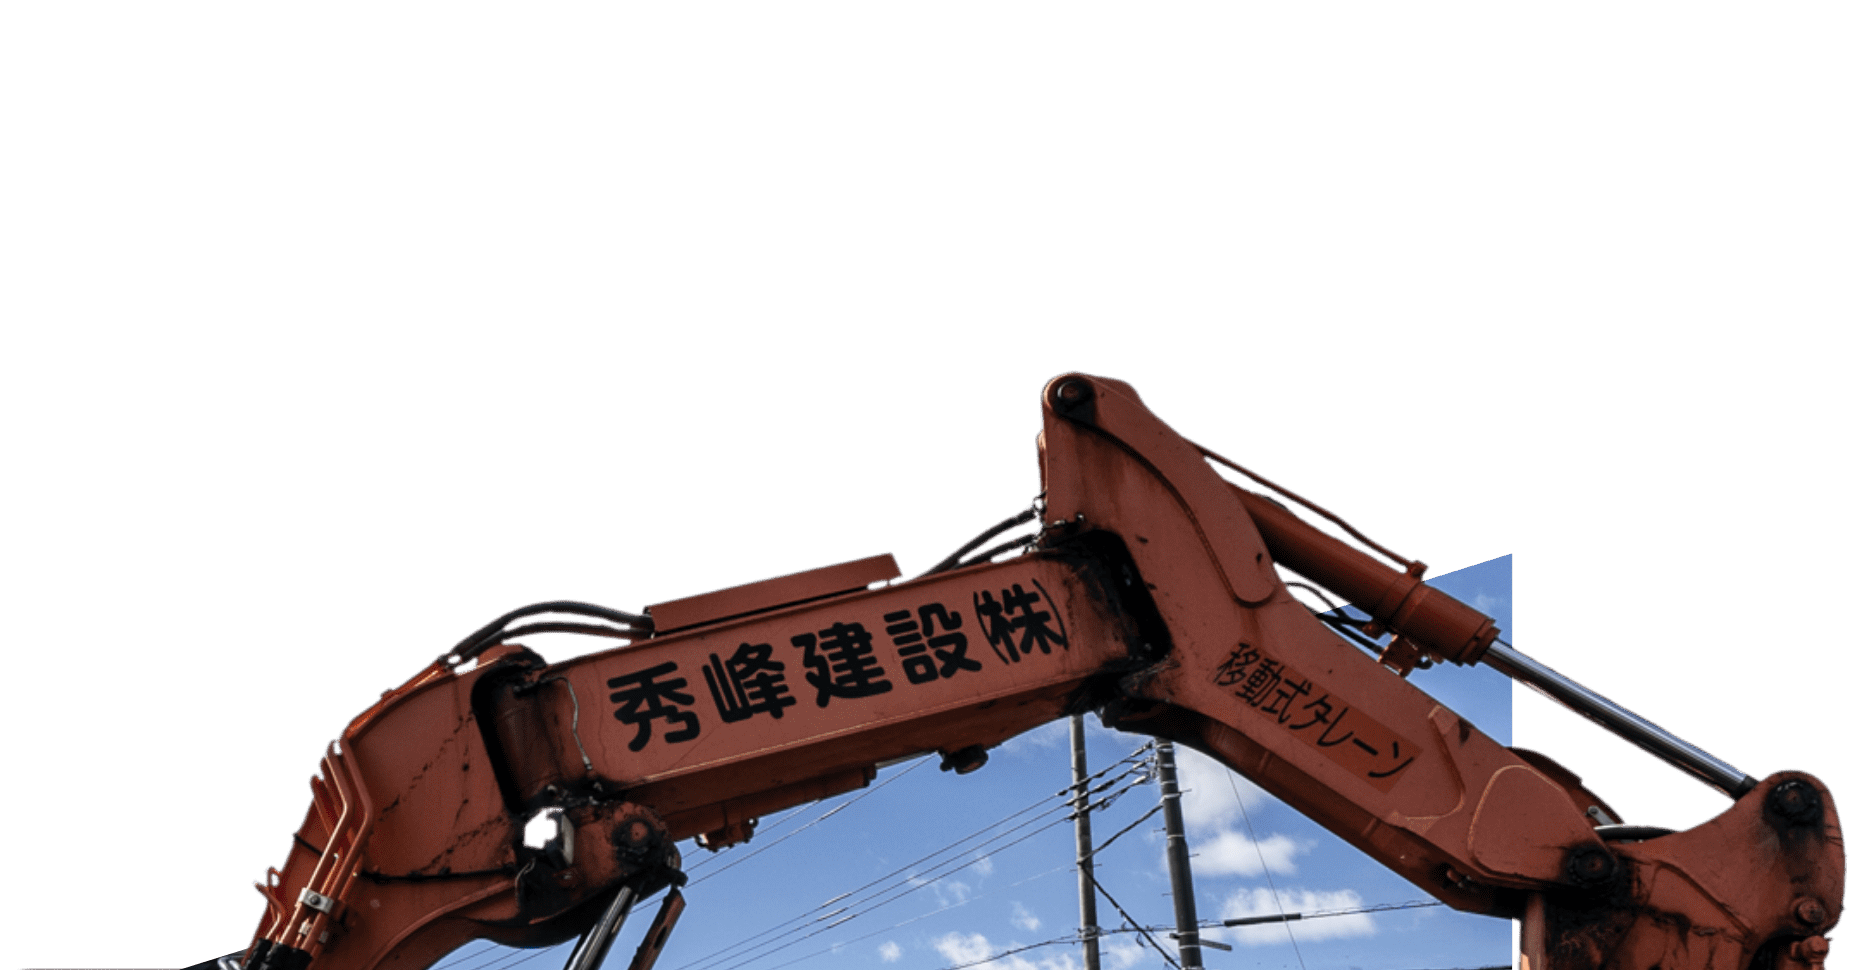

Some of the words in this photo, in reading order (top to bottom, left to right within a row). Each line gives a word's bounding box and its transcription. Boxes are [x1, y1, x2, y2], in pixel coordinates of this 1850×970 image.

[607, 578, 1068, 752] 秀峰建設(株)
